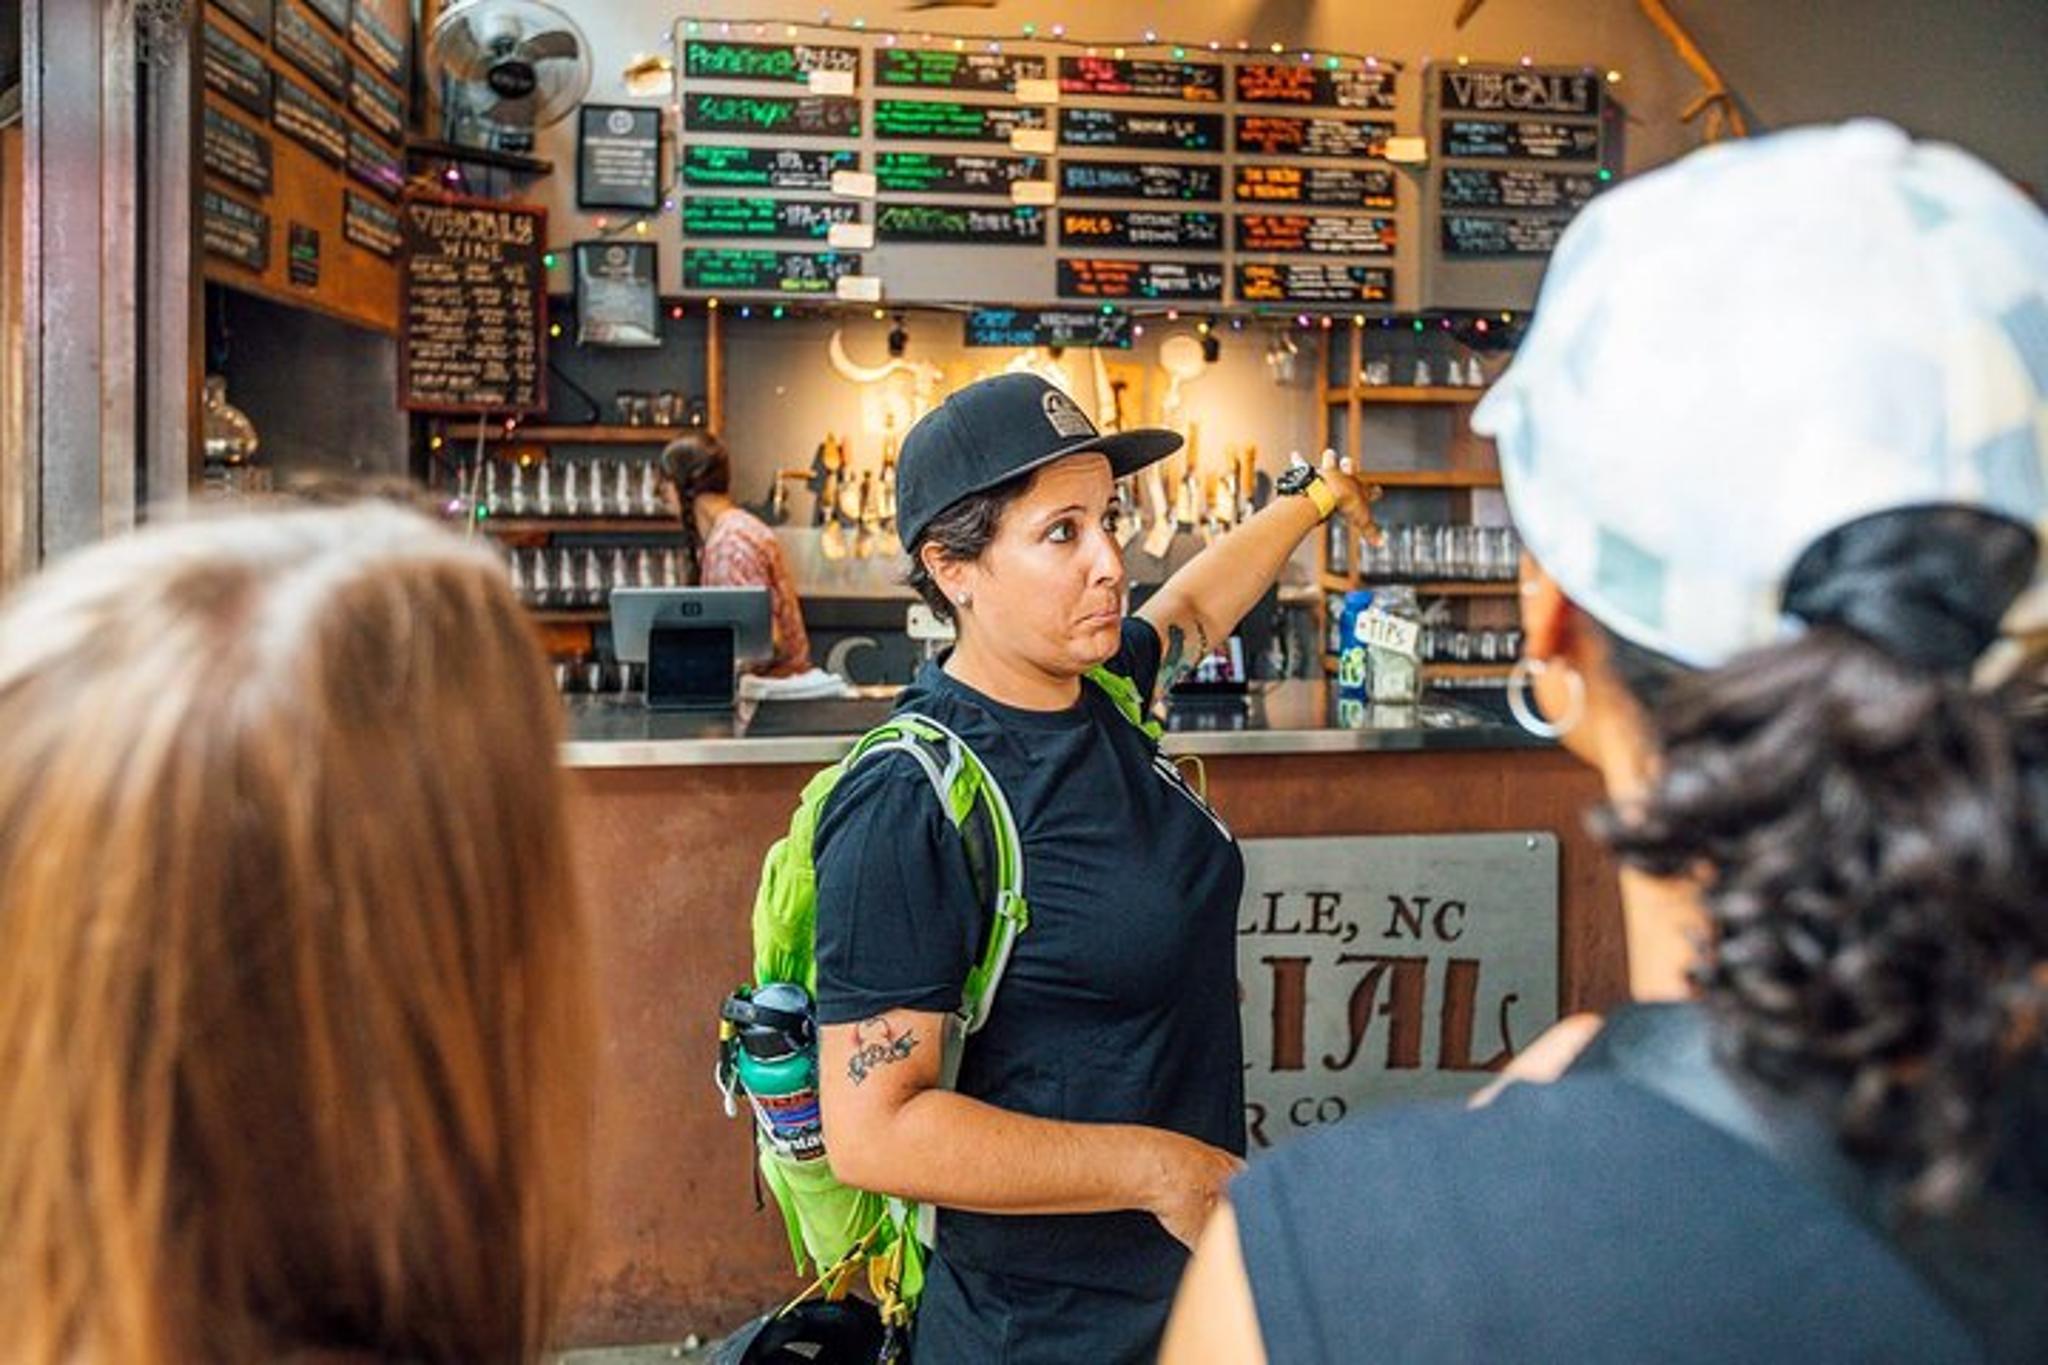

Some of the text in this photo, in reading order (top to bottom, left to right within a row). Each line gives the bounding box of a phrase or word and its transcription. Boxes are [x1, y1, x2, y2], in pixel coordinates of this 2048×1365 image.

[1383, 894, 1467, 942] NC
[1241, 953, 1519, 1073] IAL
[1289, 1096, 1347, 1128] CO
